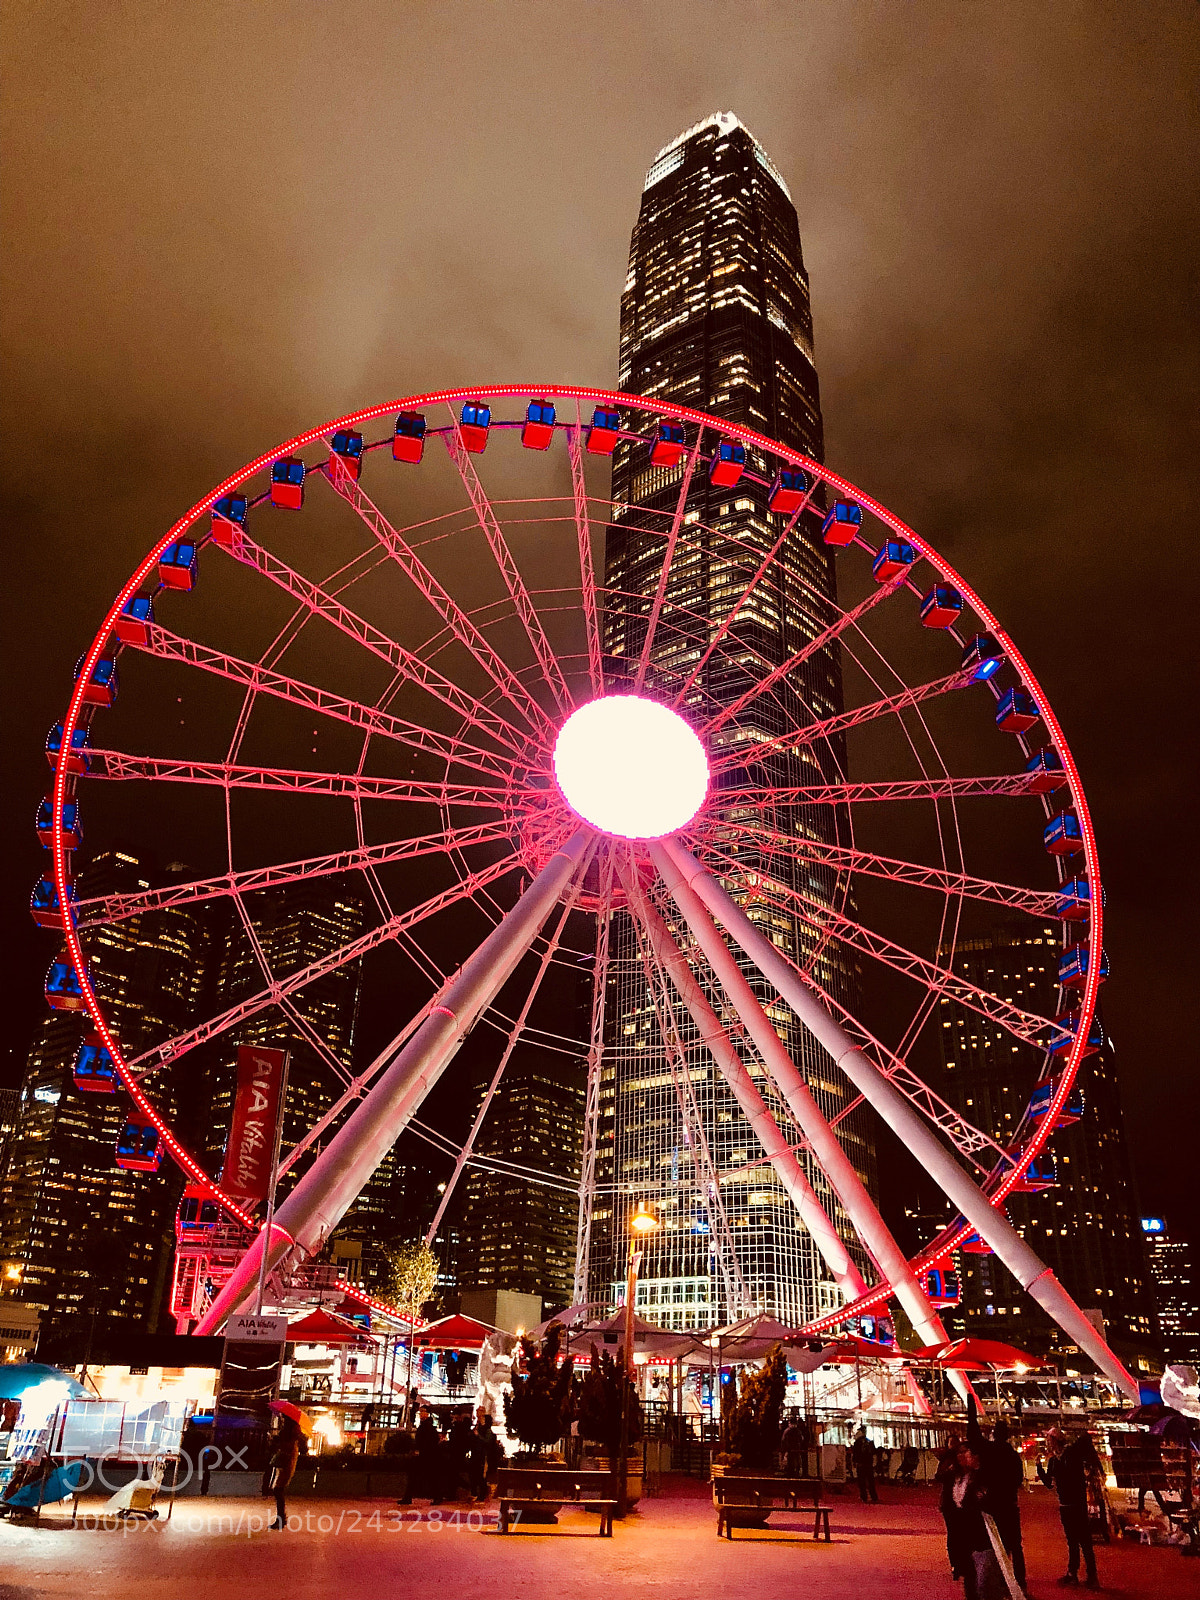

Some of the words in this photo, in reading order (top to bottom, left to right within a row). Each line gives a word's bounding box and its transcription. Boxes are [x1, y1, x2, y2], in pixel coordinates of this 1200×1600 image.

[247, 1056, 273, 1114] AIA
[234, 1120, 267, 1189] Vitality
[238, 1319, 256, 1328] AIA
